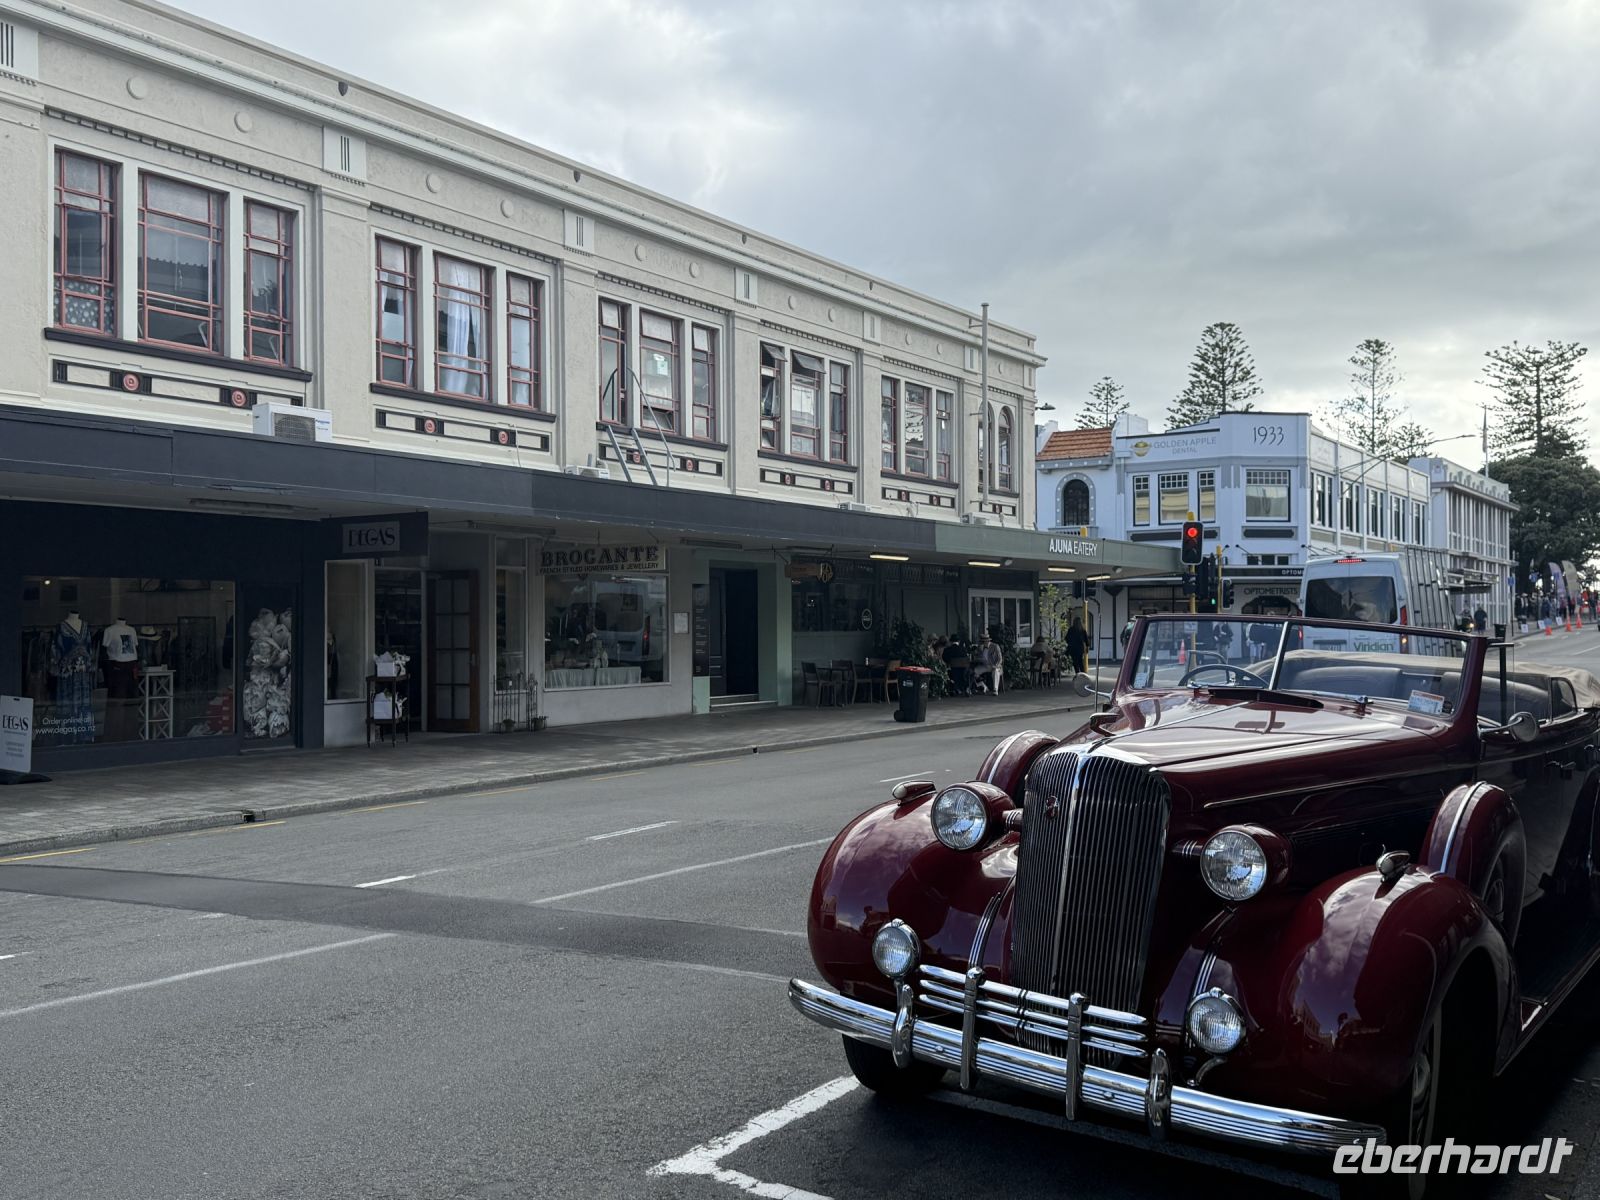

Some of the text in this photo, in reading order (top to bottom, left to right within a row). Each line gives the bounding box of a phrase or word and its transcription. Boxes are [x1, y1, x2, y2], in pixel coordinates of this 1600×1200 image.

[1253, 426, 1285, 446] 1933
[1154, 436, 1217, 449] GOLDEN APPLE
[1172, 447, 1198, 455] DENTAL
[348, 528, 395, 546] DEGAS
[1049, 538, 1097, 557] AJUNA EATERY
[626, 562, 658, 570] JEWELLERY
[1244, 587, 1298, 595] OPTOMETRISTS
[1353, 641, 1394, 652] Viridian
[2, 714, 29, 731] DEGAS
[42, 716, 60, 725] Order
[35, 725, 96, 735] www.degas.co.nz
